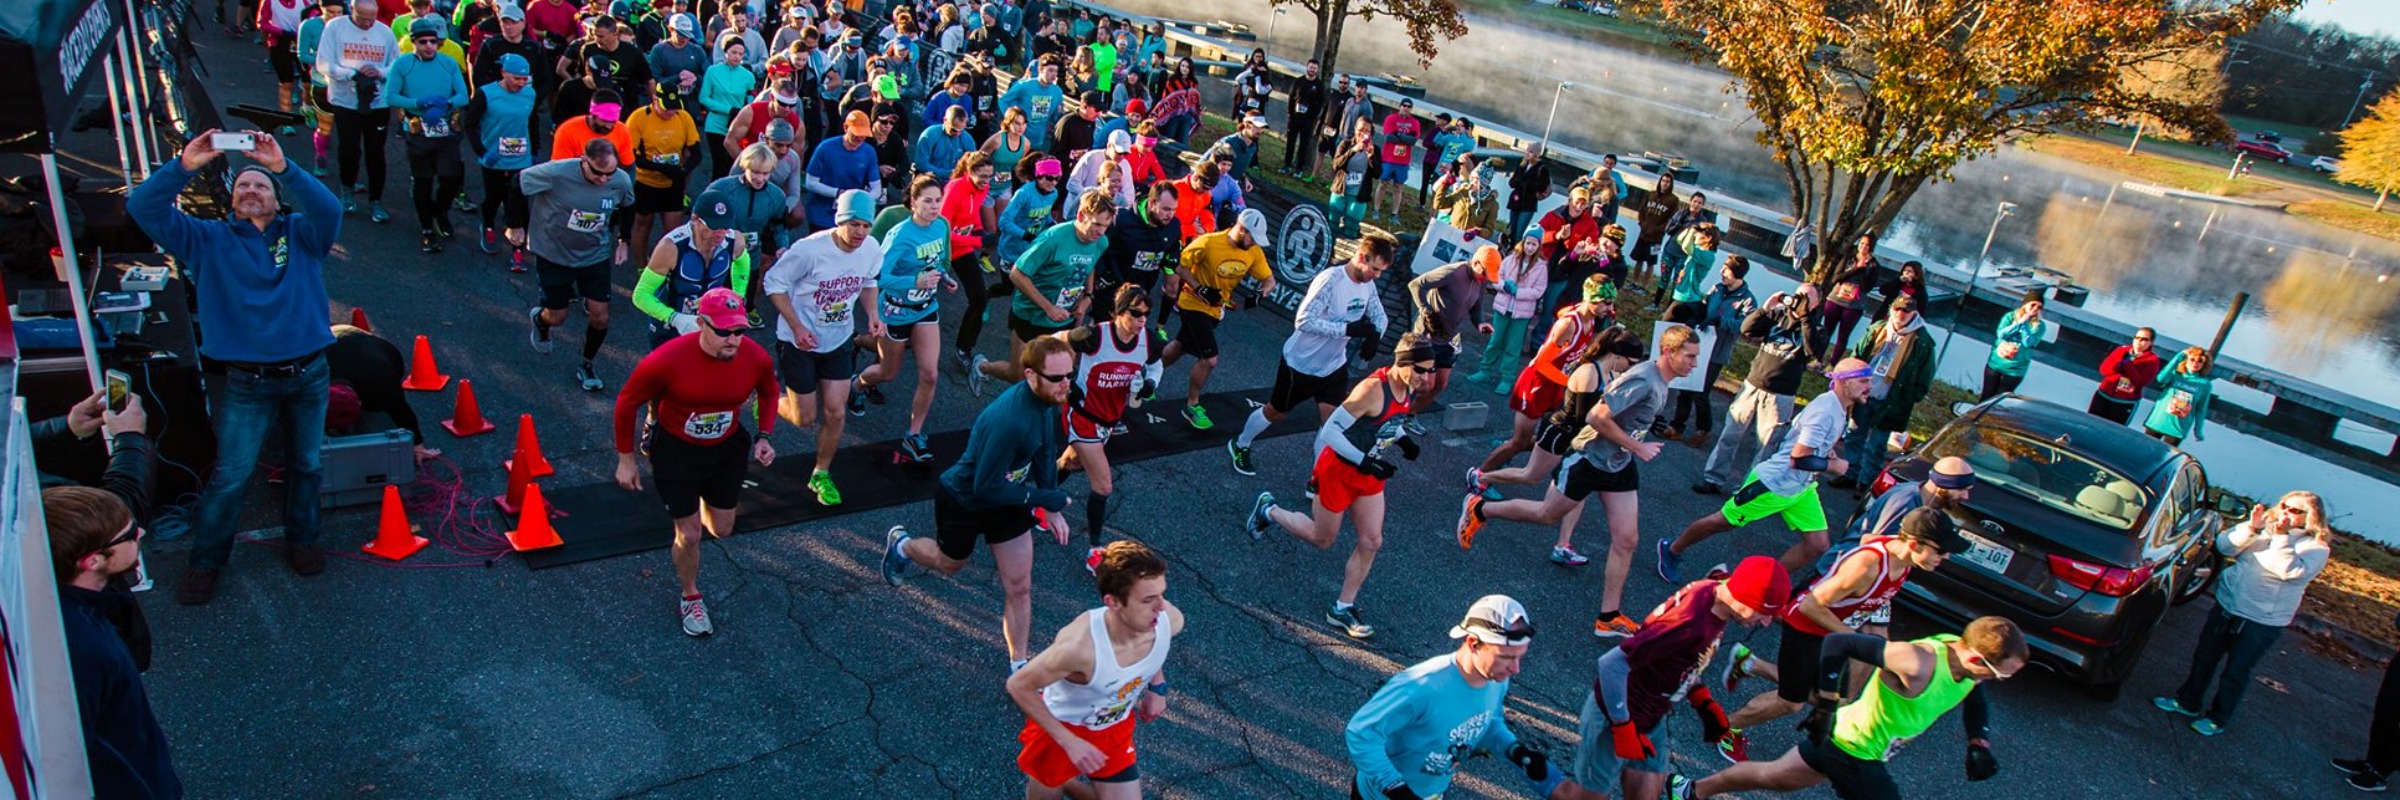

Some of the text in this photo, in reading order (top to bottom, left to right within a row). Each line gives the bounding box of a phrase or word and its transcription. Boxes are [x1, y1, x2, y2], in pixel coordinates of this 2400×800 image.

[576, 219, 599, 230] 407
[819, 276, 866, 289] SUPPORT
[825, 311, 847, 323] 528
[1097, 380, 1130, 388] MARK
[694, 421, 723, 435] 534
